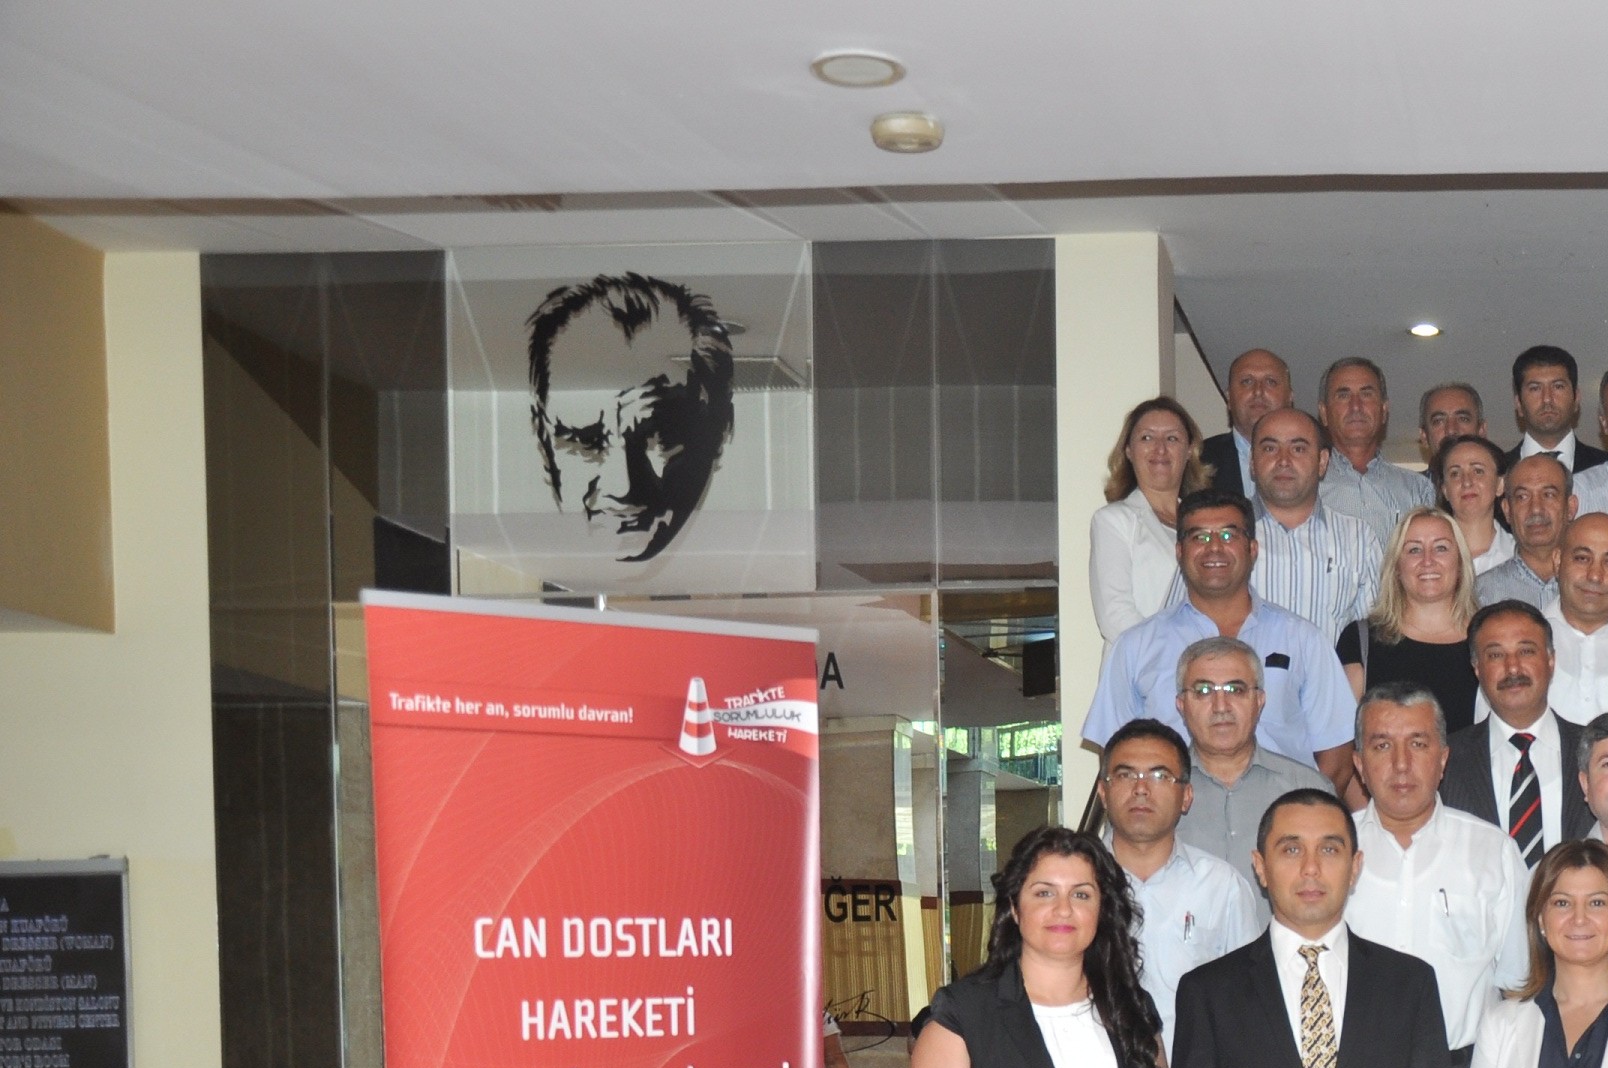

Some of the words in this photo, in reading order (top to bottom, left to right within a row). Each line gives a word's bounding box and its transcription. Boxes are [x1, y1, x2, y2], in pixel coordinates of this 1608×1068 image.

[389, 692, 451, 713] Trafikte
[455, 698, 482, 714] her
[486, 702, 509, 718] an,
[513, 703, 574, 720] sorumlu
[578, 704, 634, 723] davran!
[713, 708, 802, 722] SORUMLULUK
[727, 726, 787, 743] HAREKETİ
[474, 917, 547, 959] CAN
[562, 917, 732, 957] DOSTLARI
[521, 985, 695, 1041] HAREKETİ
